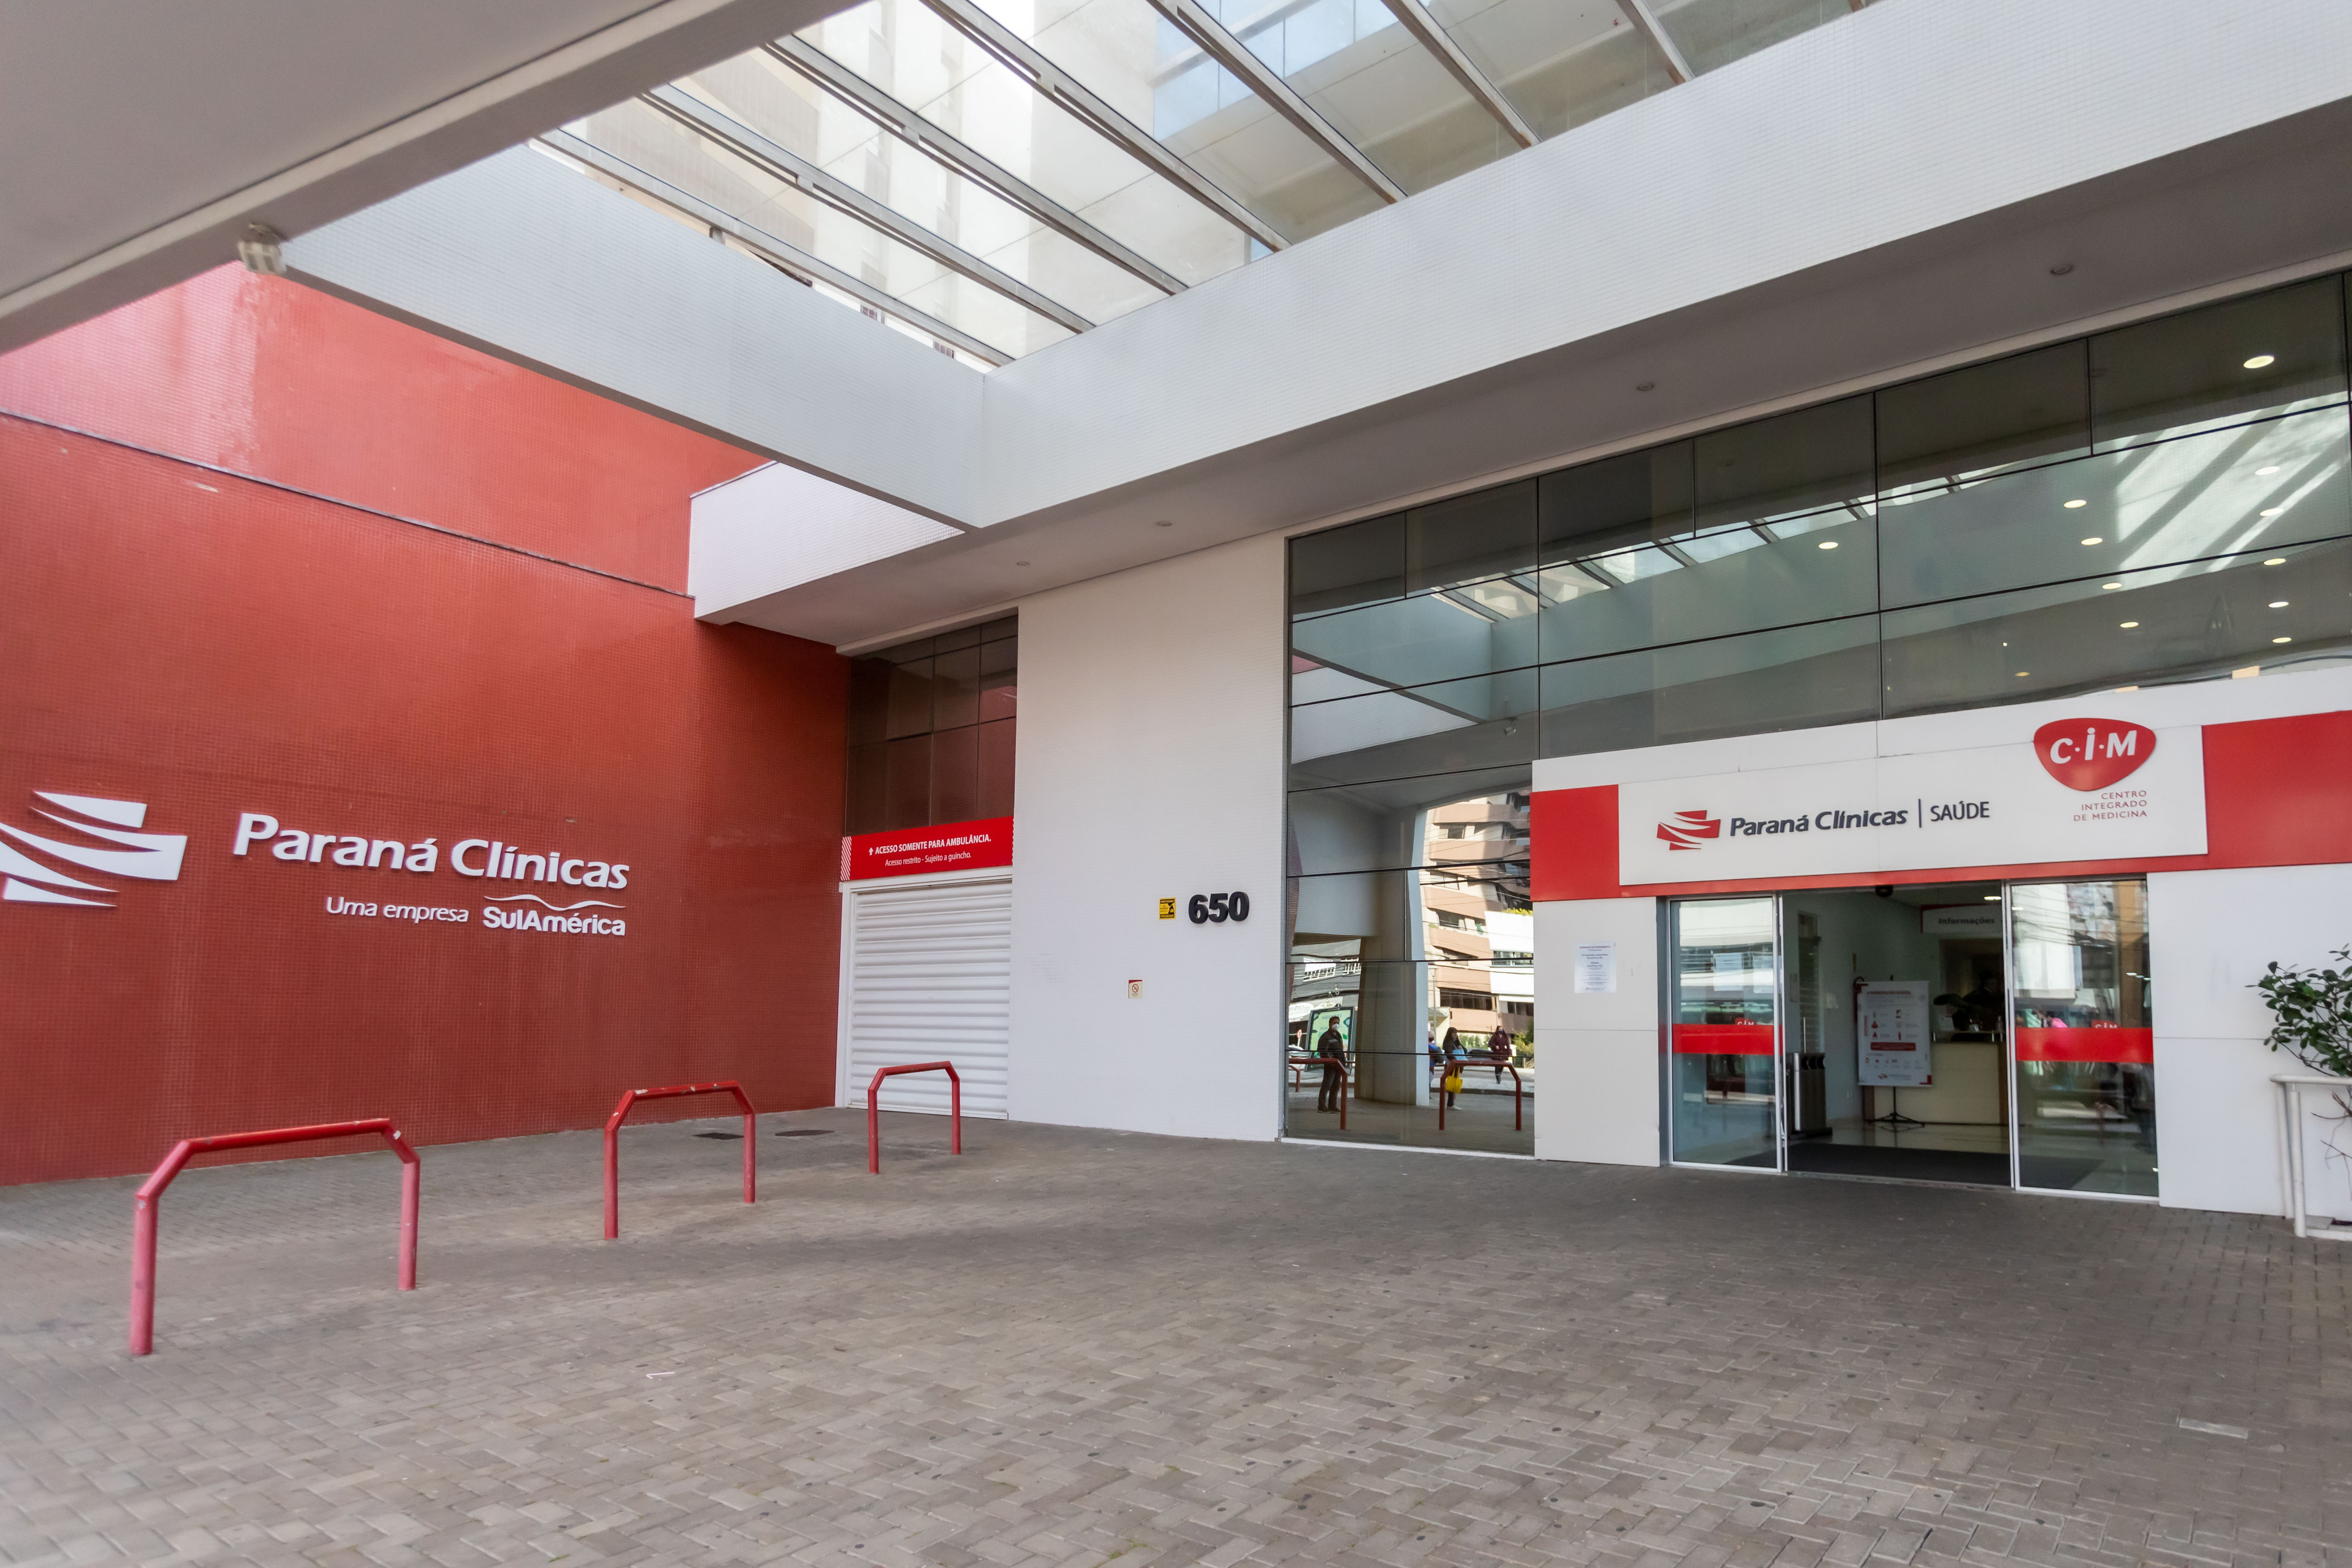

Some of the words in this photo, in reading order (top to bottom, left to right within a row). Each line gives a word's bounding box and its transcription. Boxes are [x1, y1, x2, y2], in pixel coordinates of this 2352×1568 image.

[2101, 790, 2147, 800] CENTRO
[2081, 800, 2147, 811] INTEGRADO
[1730, 815, 1809, 837] Paraná
[1815, 810, 1908, 831] Clínicas
[1930, 801, 1990, 822] SAÚDE
[2092, 810, 2147, 820] MEDICINA
[233, 812, 438, 873] Paraná
[450, 838, 630, 890] Clínicas
[875, 845, 898, 854] ACESSO
[898, 841, 927, 852] SOMENTE
[928, 839, 945, 849] PARA
[946, 834, 992, 847] AMBULÂNCIA.
[925, 854, 943, 863] Sujeito
[948, 851, 972, 862] guincho.
[1188, 891, 1250, 924] 650
[326, 896, 378, 917] Uma
[383, 904, 469, 924] empresa
[483, 905, 627, 936] SulAmérica
[1939, 917, 1995, 926] Informações
